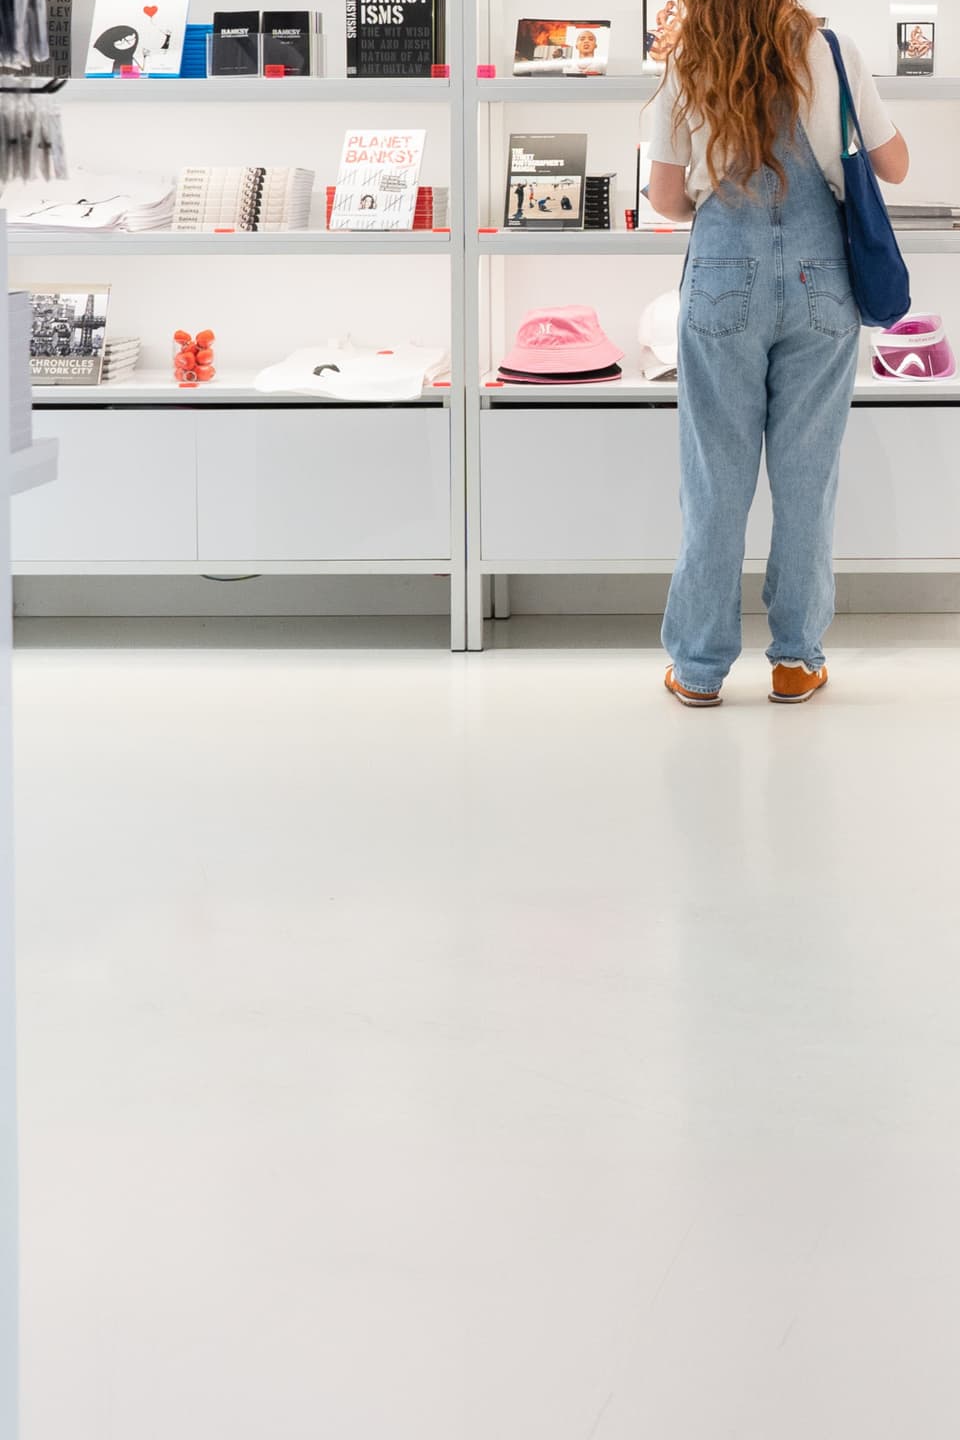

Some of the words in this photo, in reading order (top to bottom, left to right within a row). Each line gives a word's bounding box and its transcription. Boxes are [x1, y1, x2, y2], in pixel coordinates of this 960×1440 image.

[360, 4, 405, 25] ISMS
[361, 26, 381, 38] THE
[384, 26, 402, 38] WIT
[406, 26, 430, 38] WISD
[361, 39, 375, 49] OM
[379, 39, 399, 49] AND
[361, 51, 397, 63] RATION
[400, 51, 413, 63] OF
[362, 64, 380, 75] ART
[348, 136, 413, 148] PLANET
[345, 149, 419, 164] BANKSY
[30, 359, 95, 368] CHRONICLES
[44, 367, 69, 375] YORK
[71, 367, 93, 375] CITY
